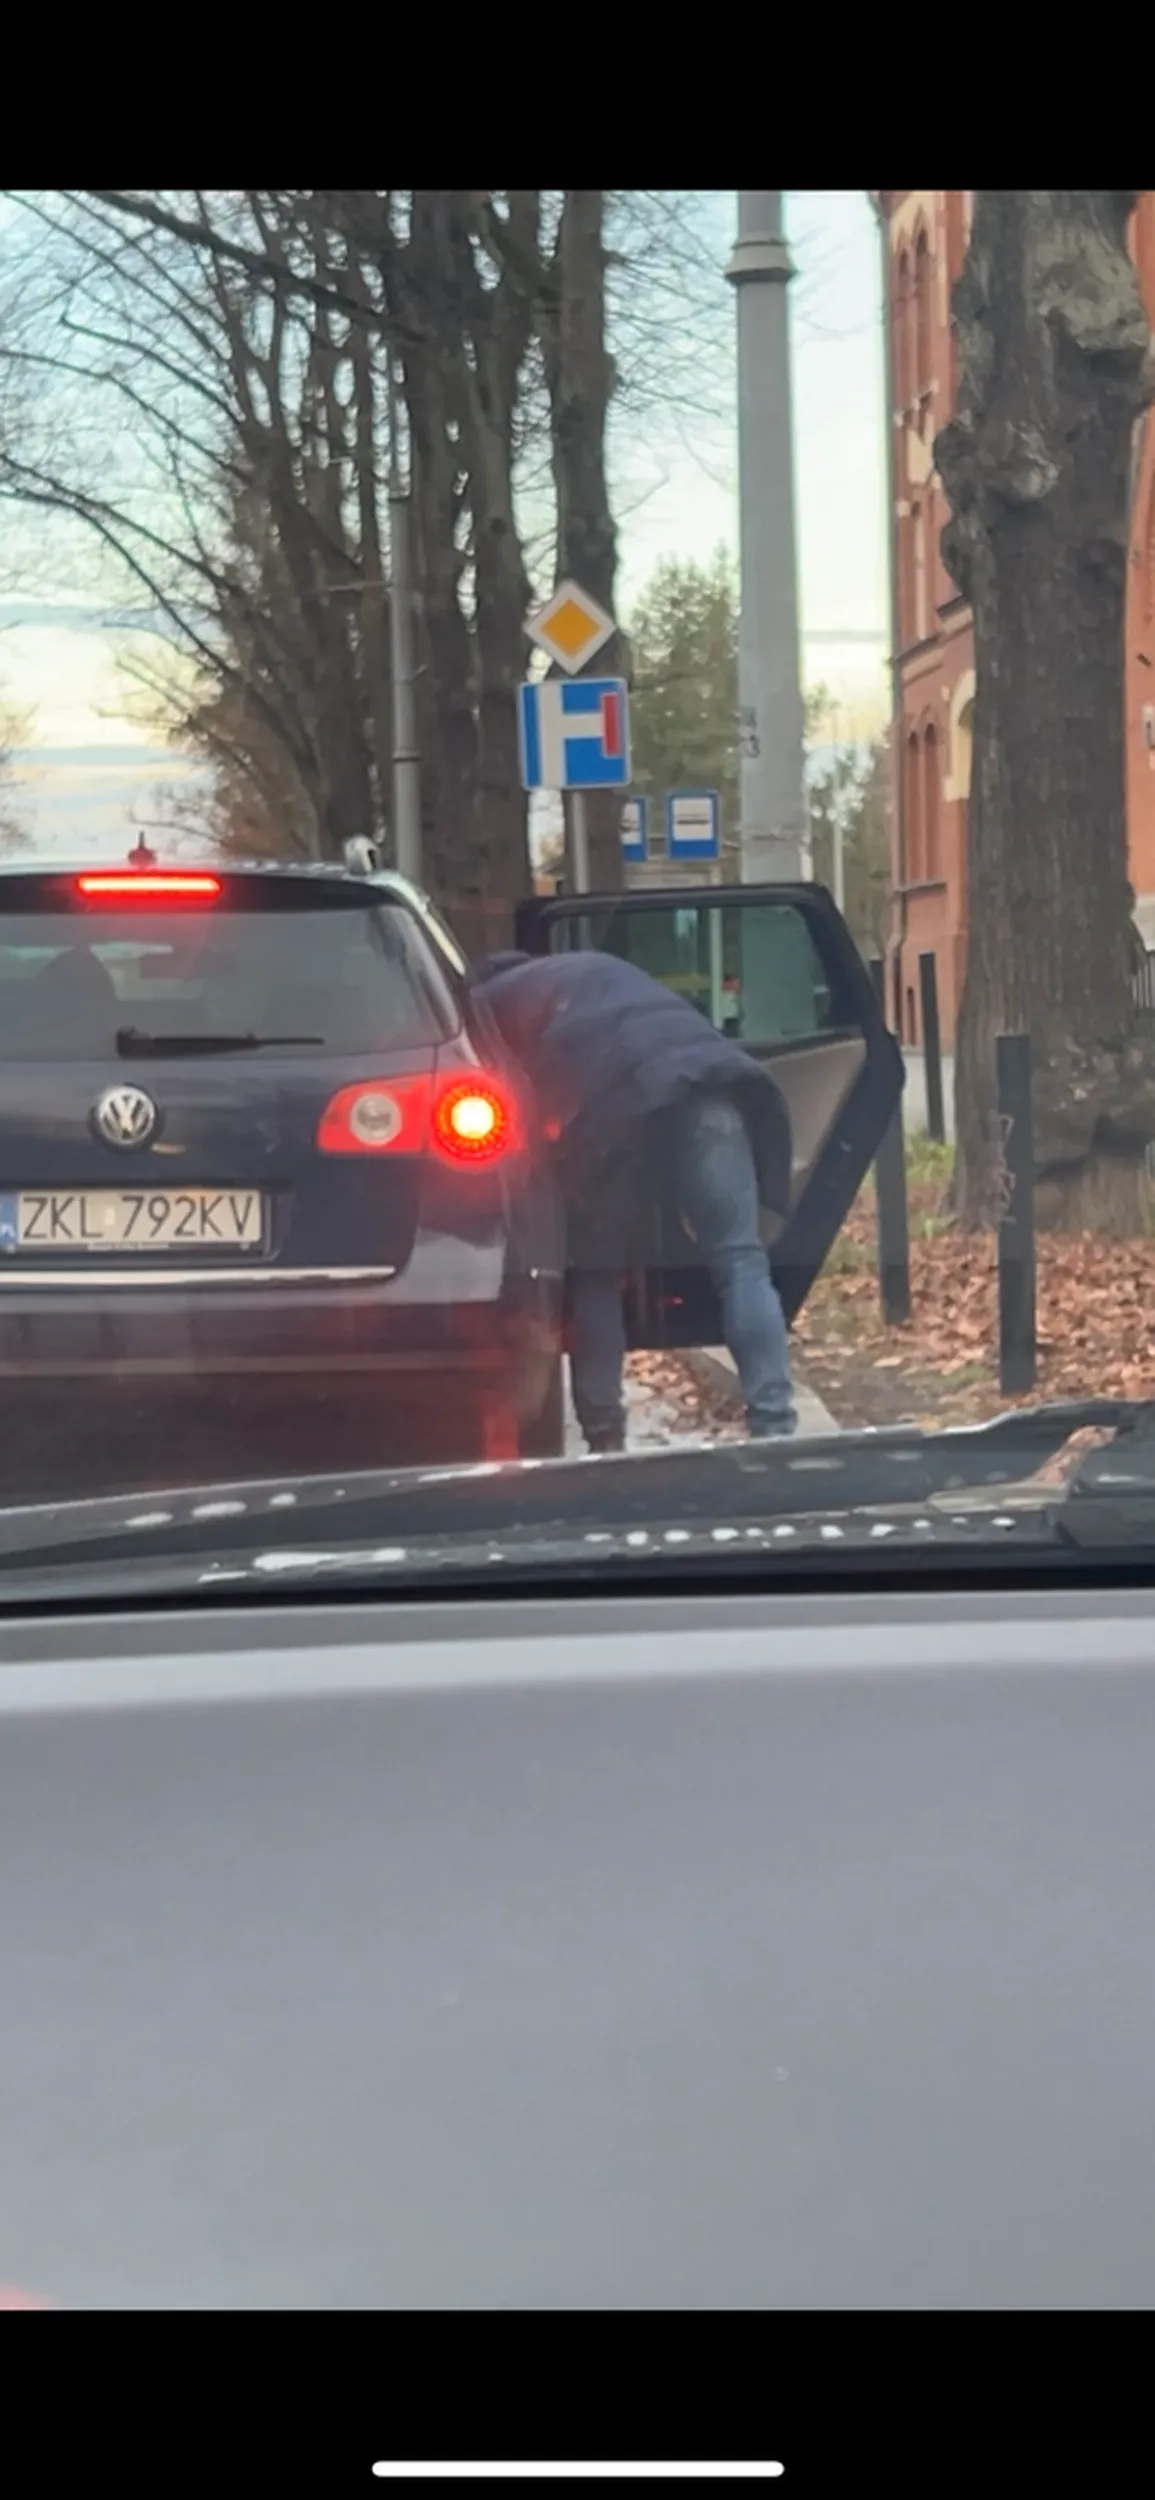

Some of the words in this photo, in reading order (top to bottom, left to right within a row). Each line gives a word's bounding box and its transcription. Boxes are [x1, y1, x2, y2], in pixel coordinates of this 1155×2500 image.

[100, 1088, 154, 1143] VW
[22, 1196, 103, 1239] ZKL
[122, 1195, 254, 1238] 792KV
